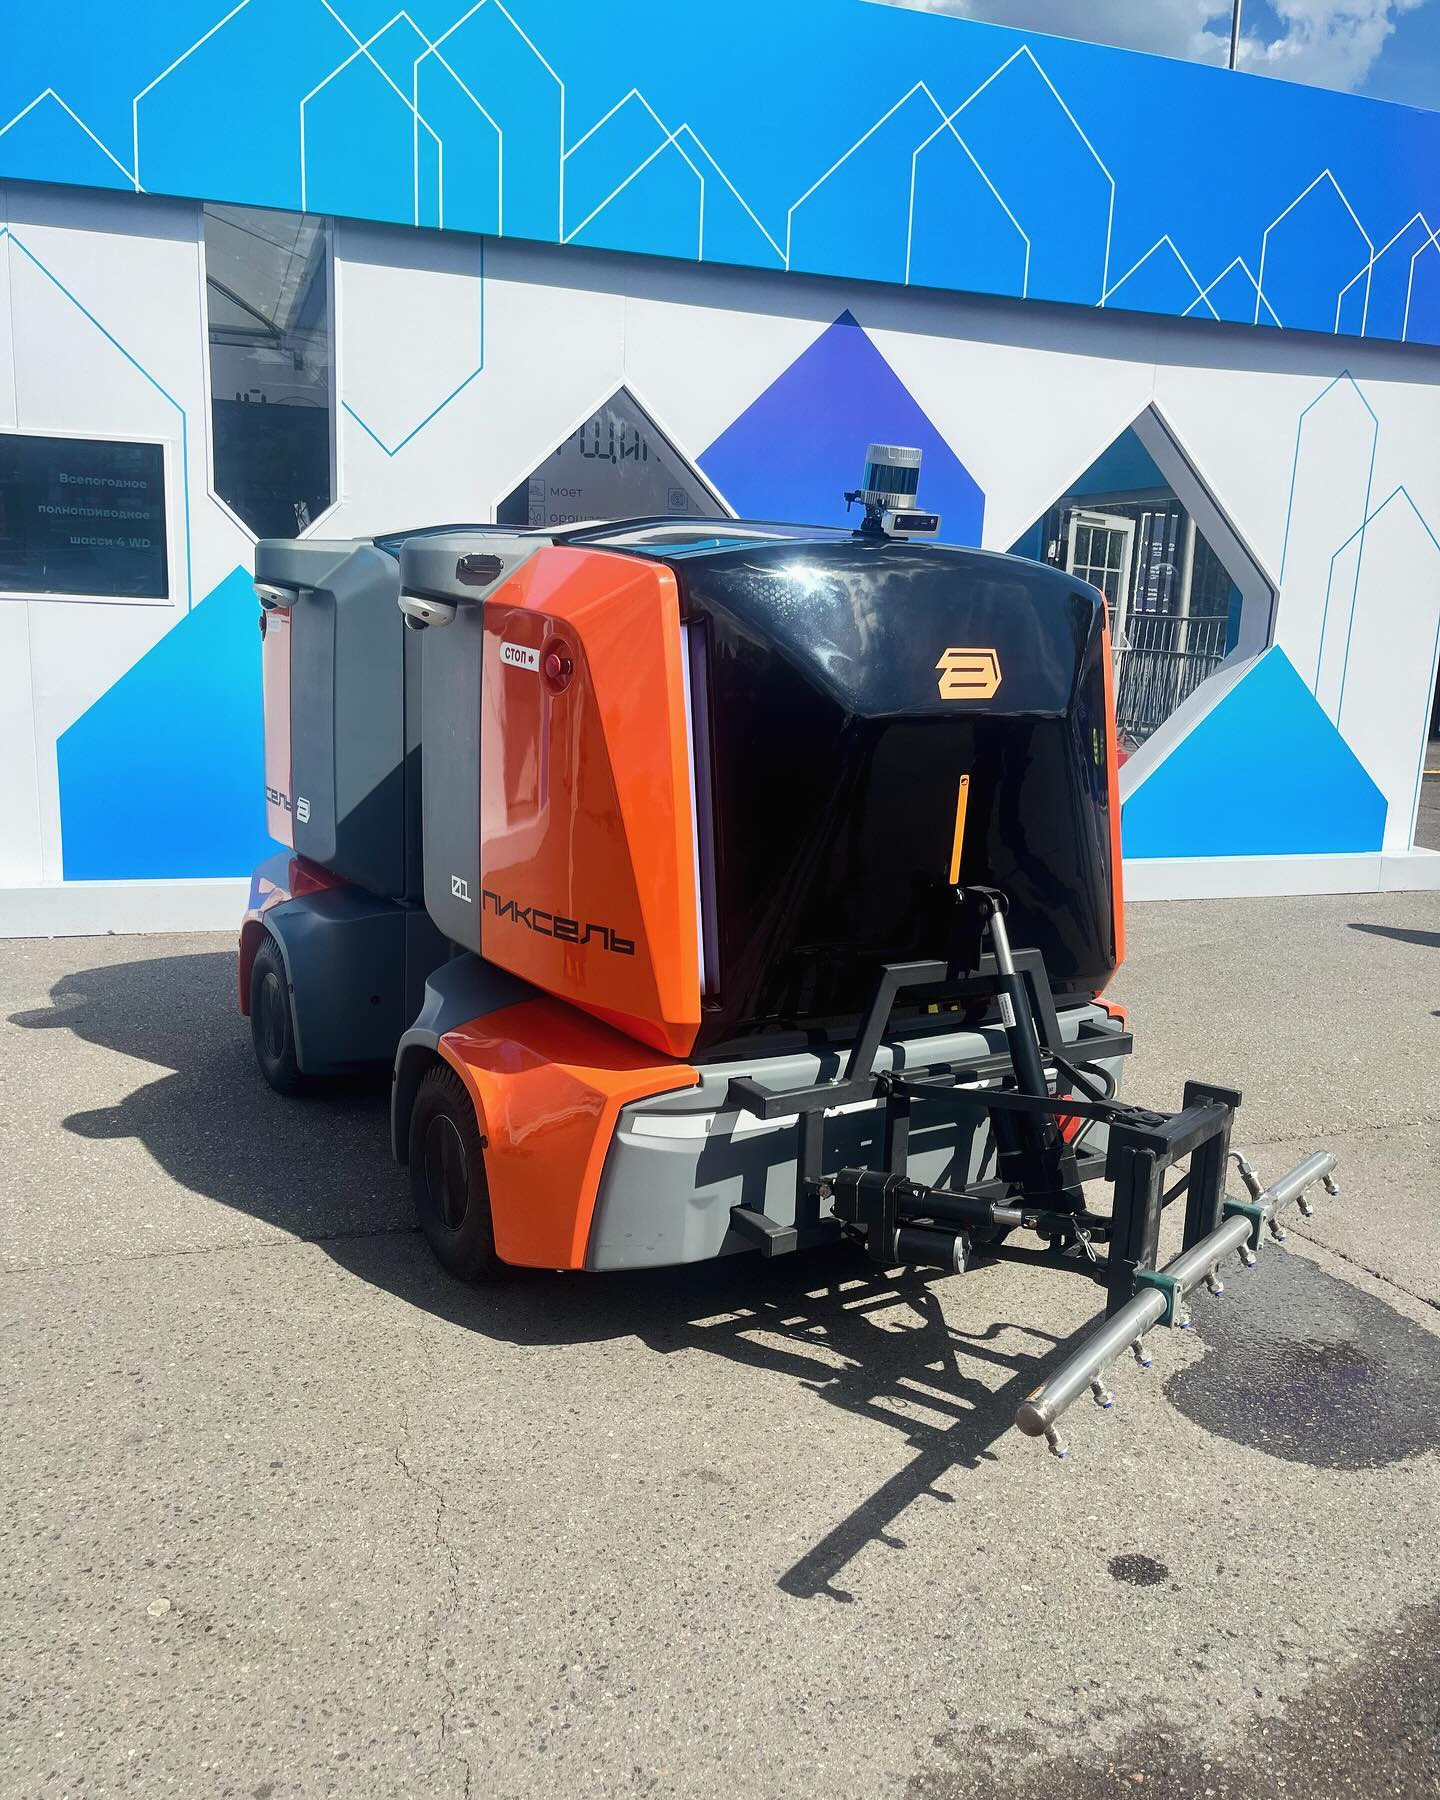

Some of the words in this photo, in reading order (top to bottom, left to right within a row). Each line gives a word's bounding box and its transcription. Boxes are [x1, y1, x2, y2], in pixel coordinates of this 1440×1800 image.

[59, 473, 148, 489] Всепогодное
[550, 487, 583, 498] моет
[38, 504, 151, 520] полноприводное
[70, 536, 113, 546] шасси
[116, 537, 126, 547] 4
[128, 537, 151, 548] WD
[505, 647, 527, 664] СТОП
[451, 875, 472, 904] 01
